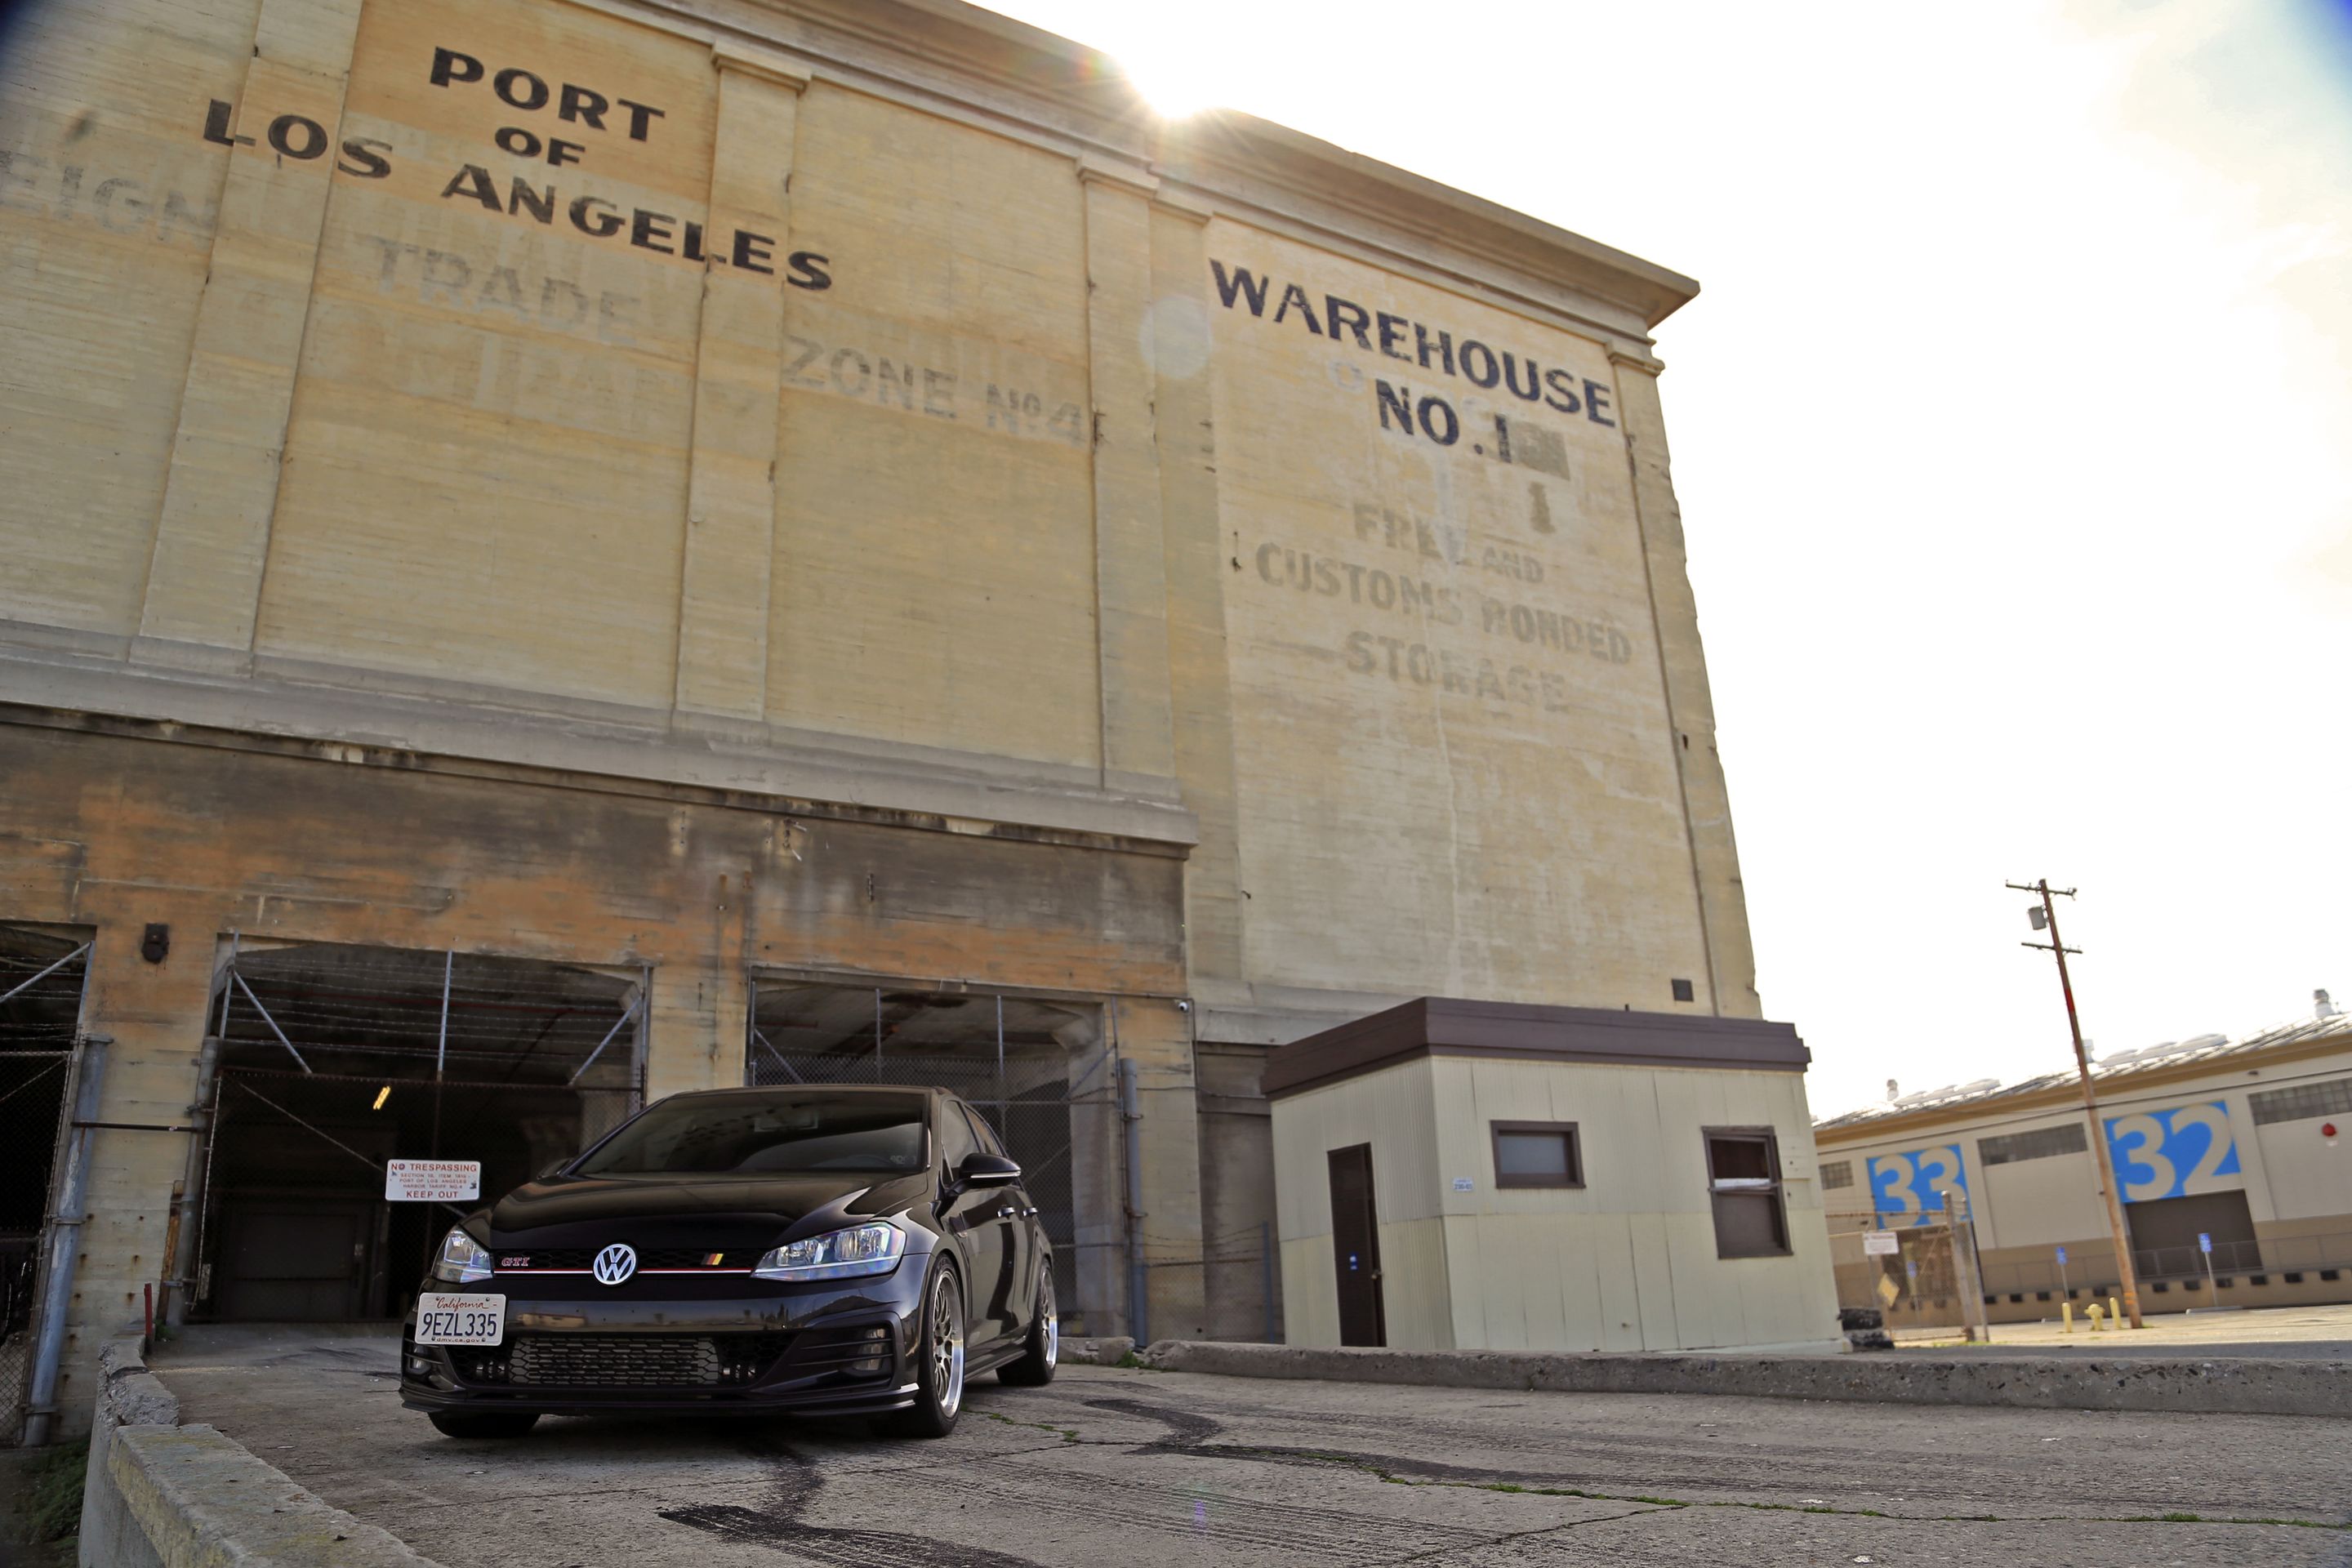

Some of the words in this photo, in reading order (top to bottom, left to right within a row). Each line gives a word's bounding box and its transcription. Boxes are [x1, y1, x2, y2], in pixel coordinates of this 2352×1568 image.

[430, 46, 665, 142] PORT
[494, 127, 586, 166] OF
[203, 98, 393, 179] LOS
[440, 163, 832, 292] ANGELES
[1209, 257, 1615, 427] WAREHOUSE
[782, 334, 958, 421] ZONE
[1482, 546, 1544, 584] AND
[1255, 542, 1463, 626] CUSTOMS
[1481, 597, 1632, 665] BONDED
[410, 1163, 477, 1172] TRESPASSING
[2114, 1104, 2245, 1201] 32
[1874, 1147, 1967, 1229] 33
[501, 1257, 531, 1267] GTI
[594, 1244, 636, 1285] VW
[421, 1312, 497, 1337] 9EZL335
[436, 1297, 489, 1312] California
